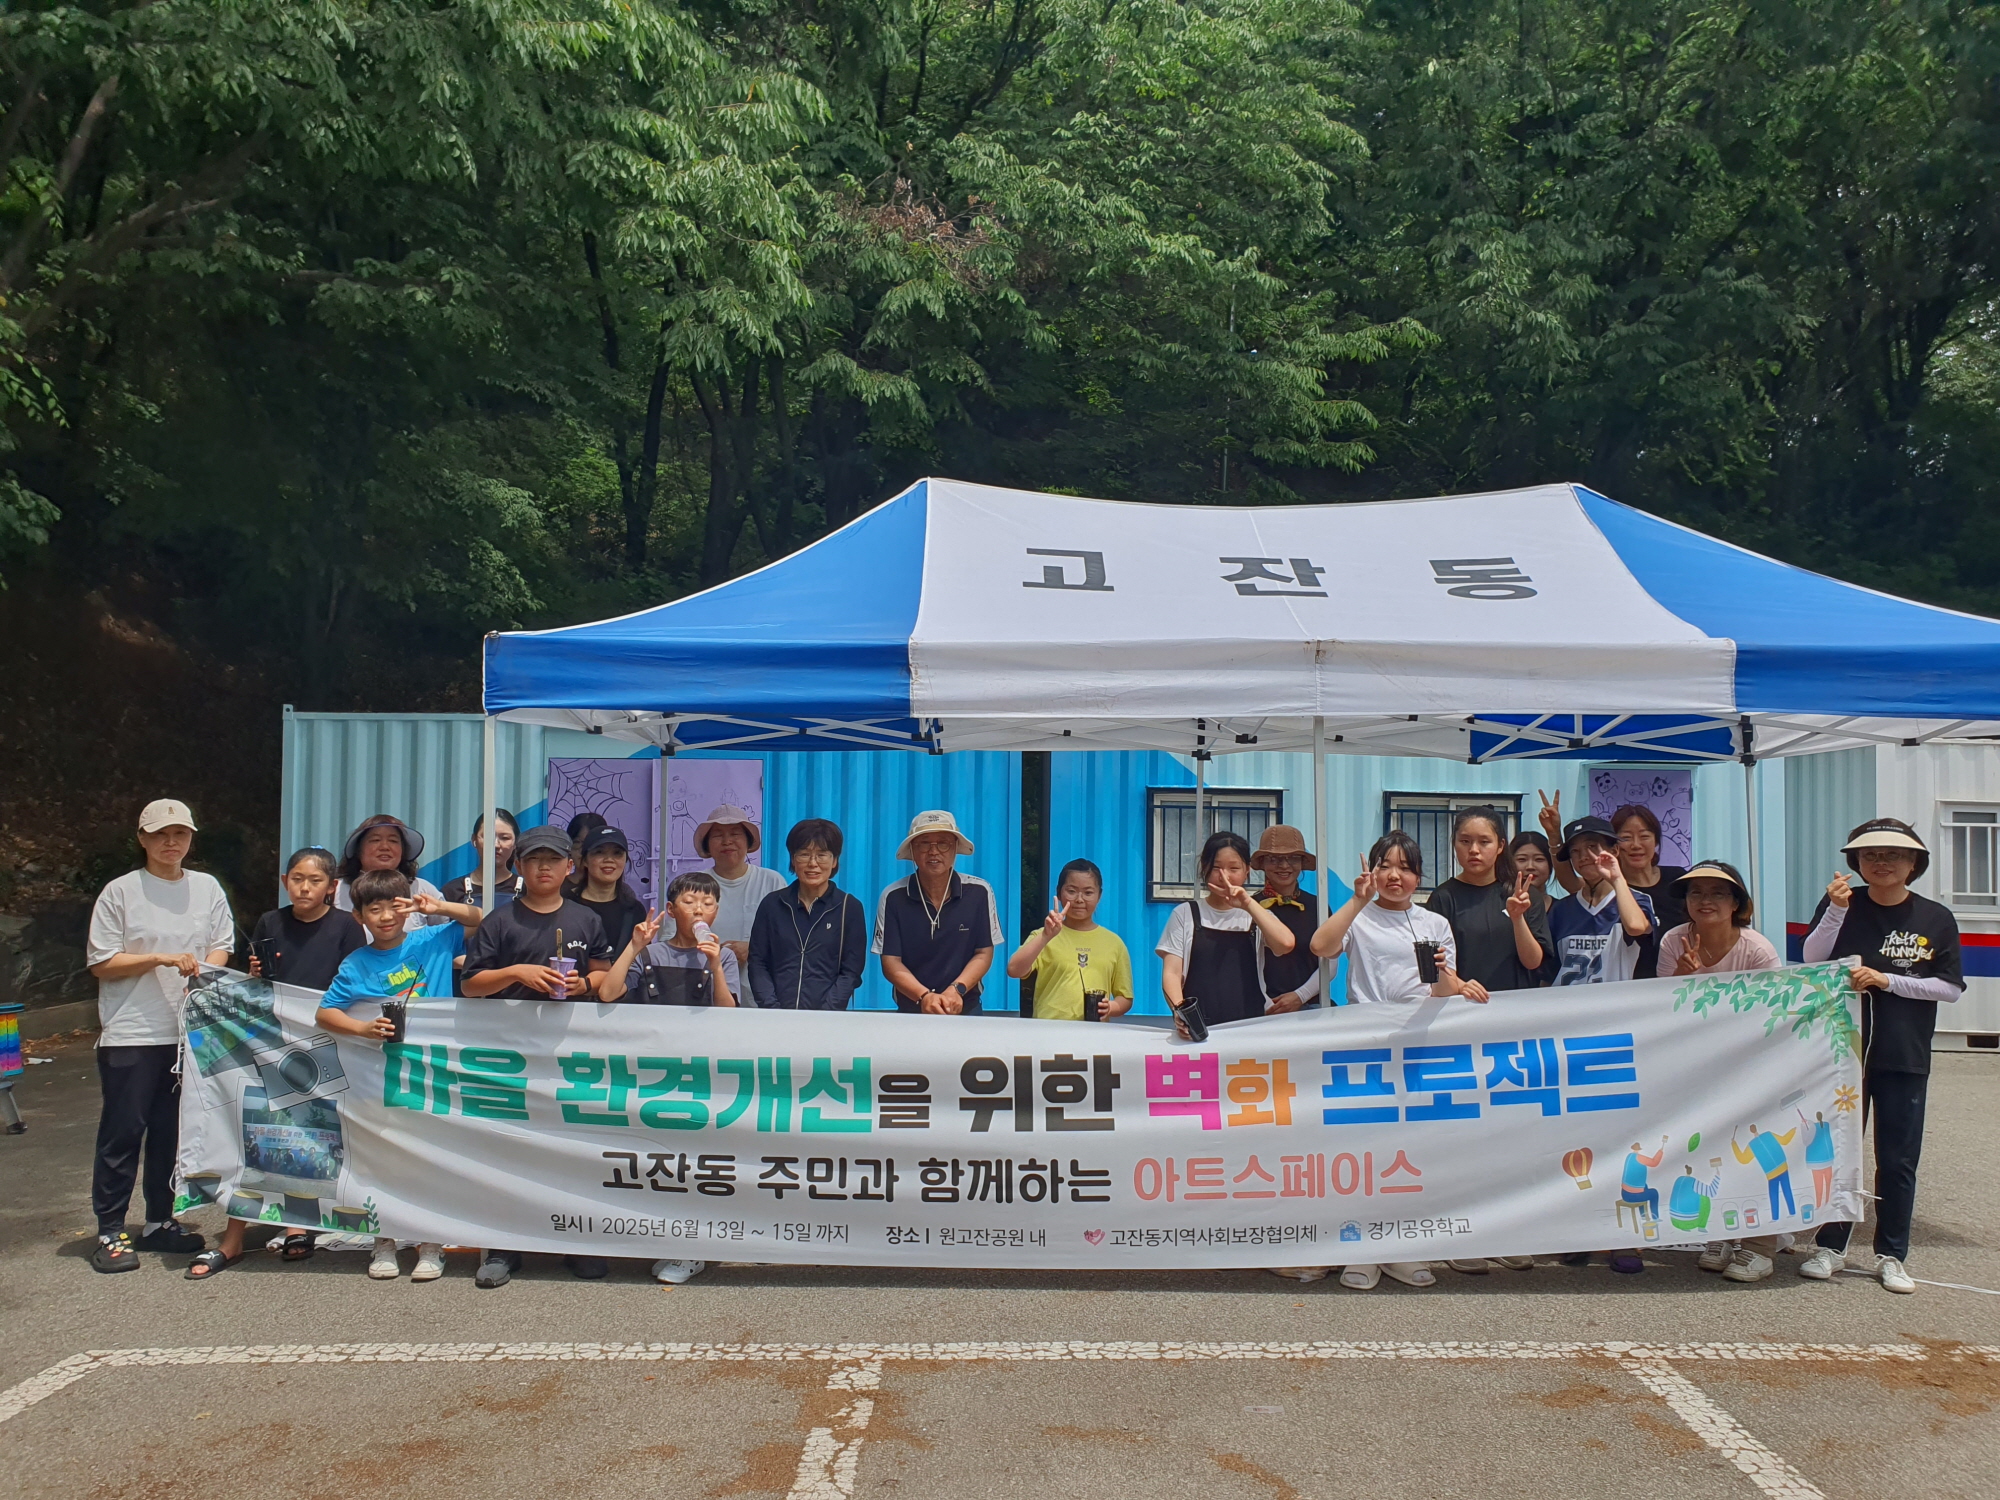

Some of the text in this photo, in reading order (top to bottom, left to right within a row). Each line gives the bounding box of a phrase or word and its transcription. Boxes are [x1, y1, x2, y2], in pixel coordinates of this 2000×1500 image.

[383, 1033, 1641, 1133] 마을 환경개선을 위한 벽화 프로젝트
[602, 1149, 1424, 1204] 고잔동 주민과 함께하는 아트스페이스
[601, 1217, 667, 1238] 2025년
[670, 1218, 700, 1240] 6월
[706, 1220, 746, 1241] 13일
[773, 1222, 811, 1243] 15일
[815, 1223, 849, 1244] 까지
[938, 1227, 1025, 1248] 원고잔공원
[1029, 1228, 1047, 1249] 내
[1109, 1223, 1318, 1248] 고잔동지역사회보장협의체
[1367, 1217, 1473, 1241] 경기공유학교
